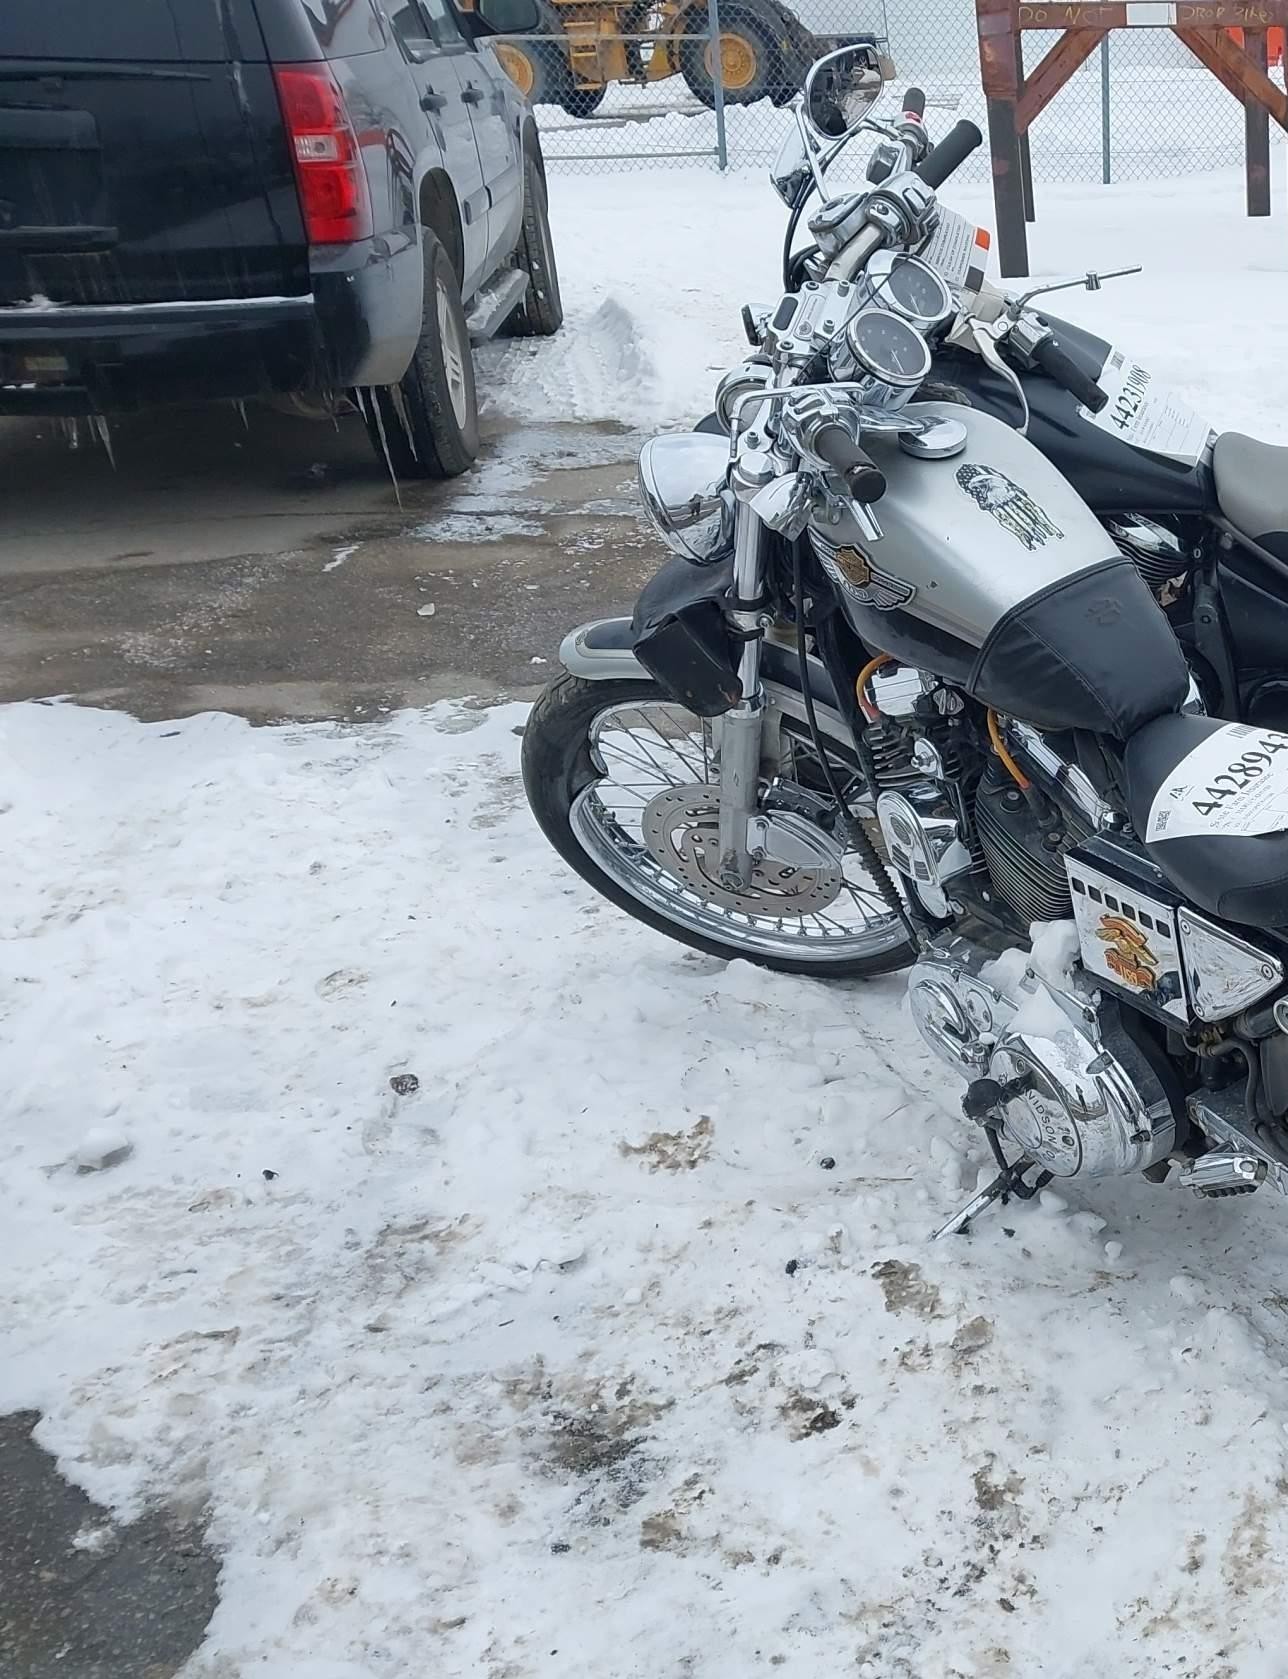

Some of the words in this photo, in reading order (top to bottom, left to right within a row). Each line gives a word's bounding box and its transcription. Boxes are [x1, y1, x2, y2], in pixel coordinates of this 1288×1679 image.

[1018, 6, 1048, 26] DO
[1063, 5, 1113, 25] NOT
[1109, 363, 1152, 430] 44231908
